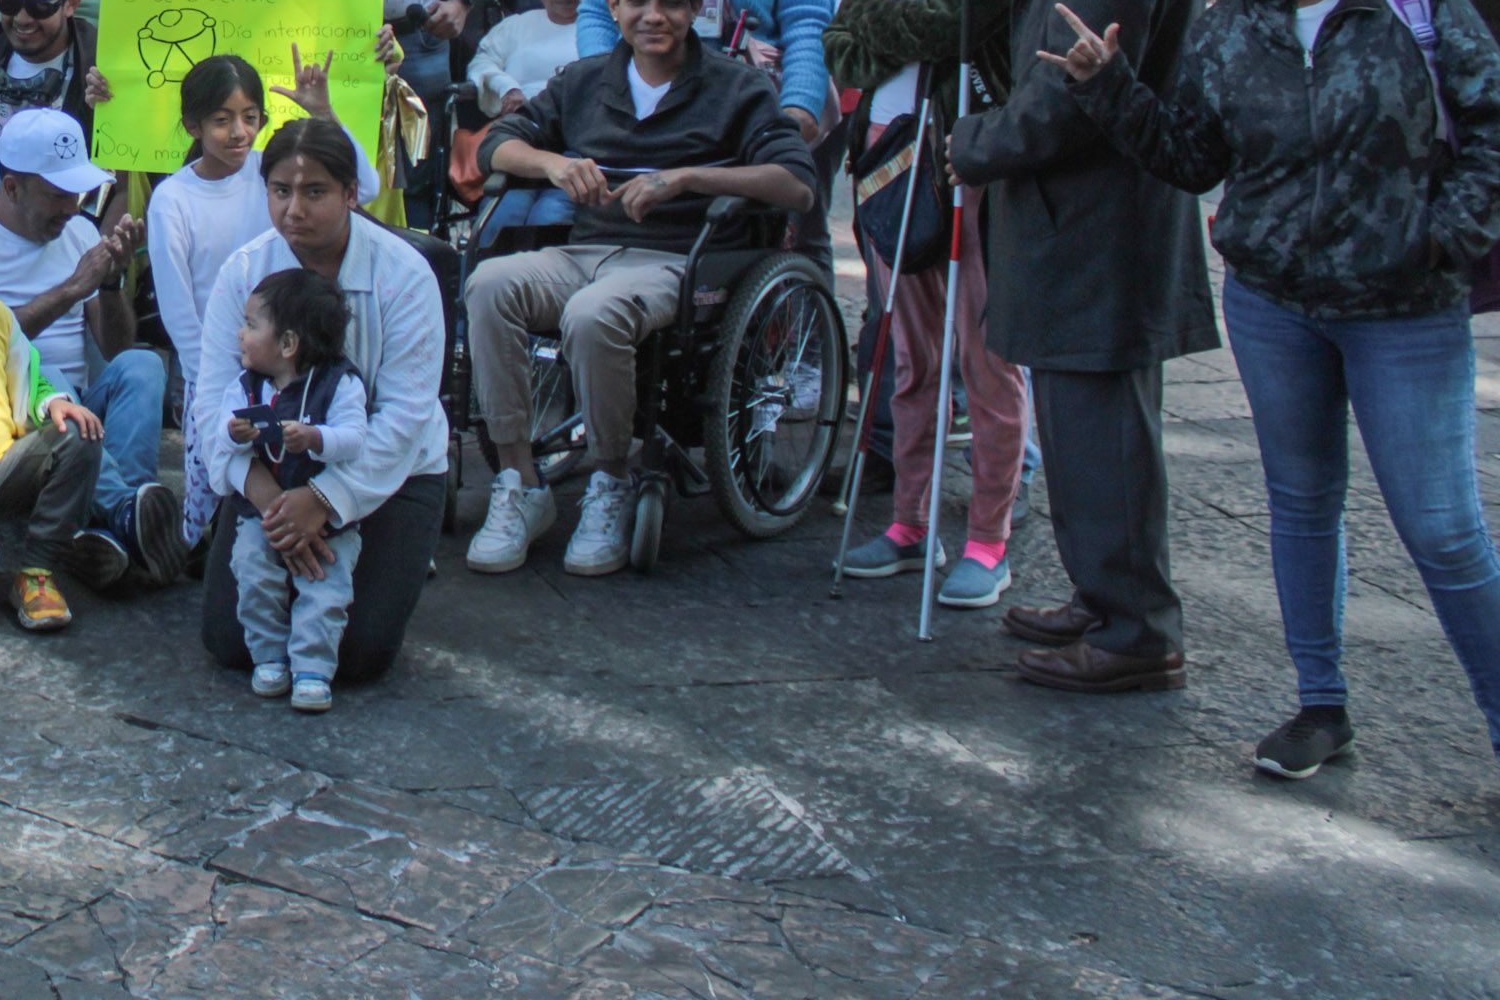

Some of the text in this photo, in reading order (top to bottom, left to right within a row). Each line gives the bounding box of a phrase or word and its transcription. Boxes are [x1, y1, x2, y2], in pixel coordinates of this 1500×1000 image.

[221, 19, 372, 40] Día internacional
[257, 48, 284, 66] las
[342, 74, 360, 89] de
